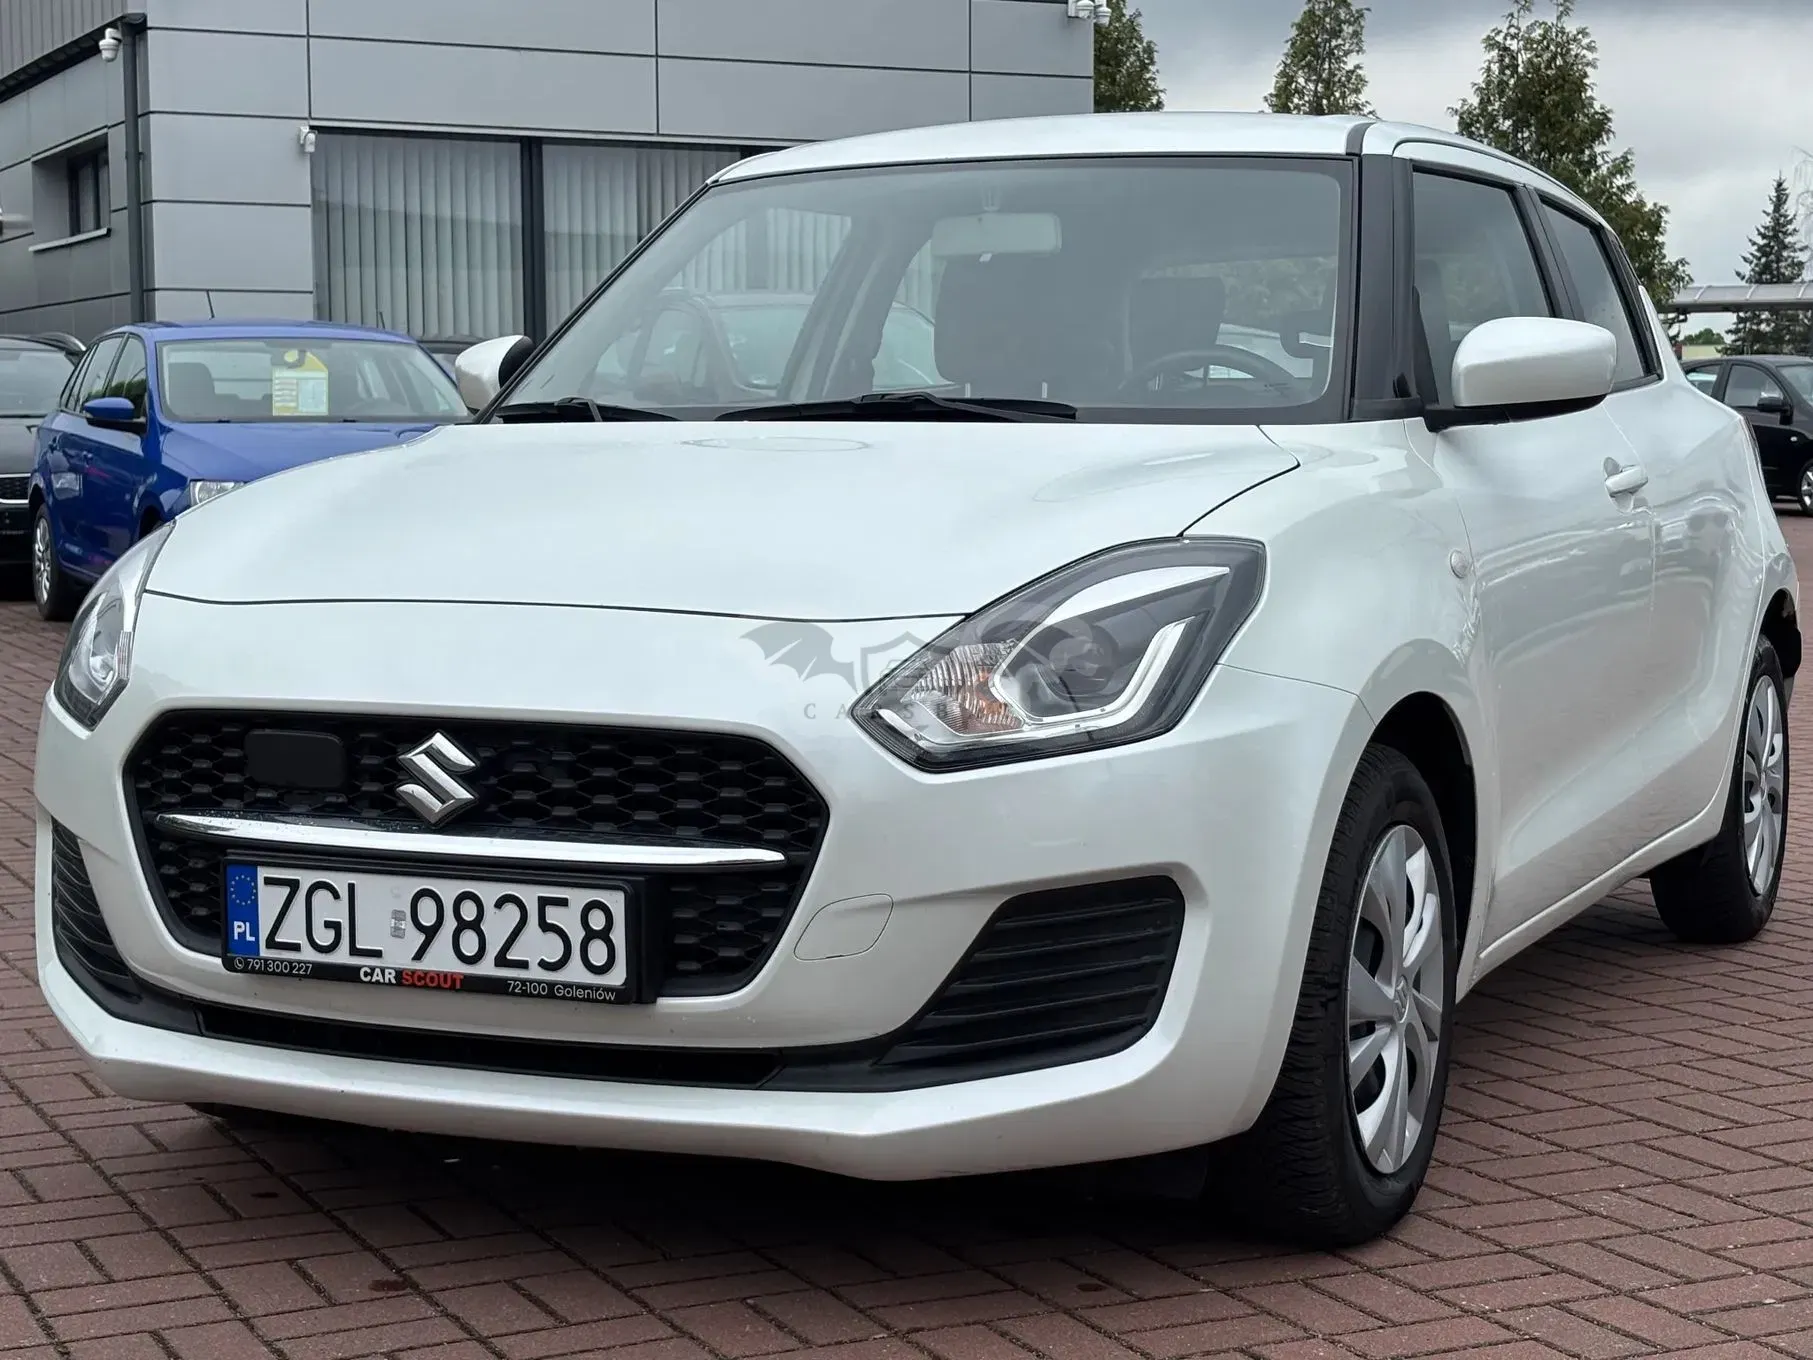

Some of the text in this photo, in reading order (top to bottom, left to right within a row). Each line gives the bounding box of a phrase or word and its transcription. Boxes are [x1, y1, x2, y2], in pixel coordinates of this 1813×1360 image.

[233, 921, 256, 942] PL
[263, 876, 616, 976] ZGL 98258
[247, 958, 313, 975] 791 300 227
[359, 966, 464, 990] CAR SCOUT
[507, 980, 617, 1001] 72-100 Goleniów
